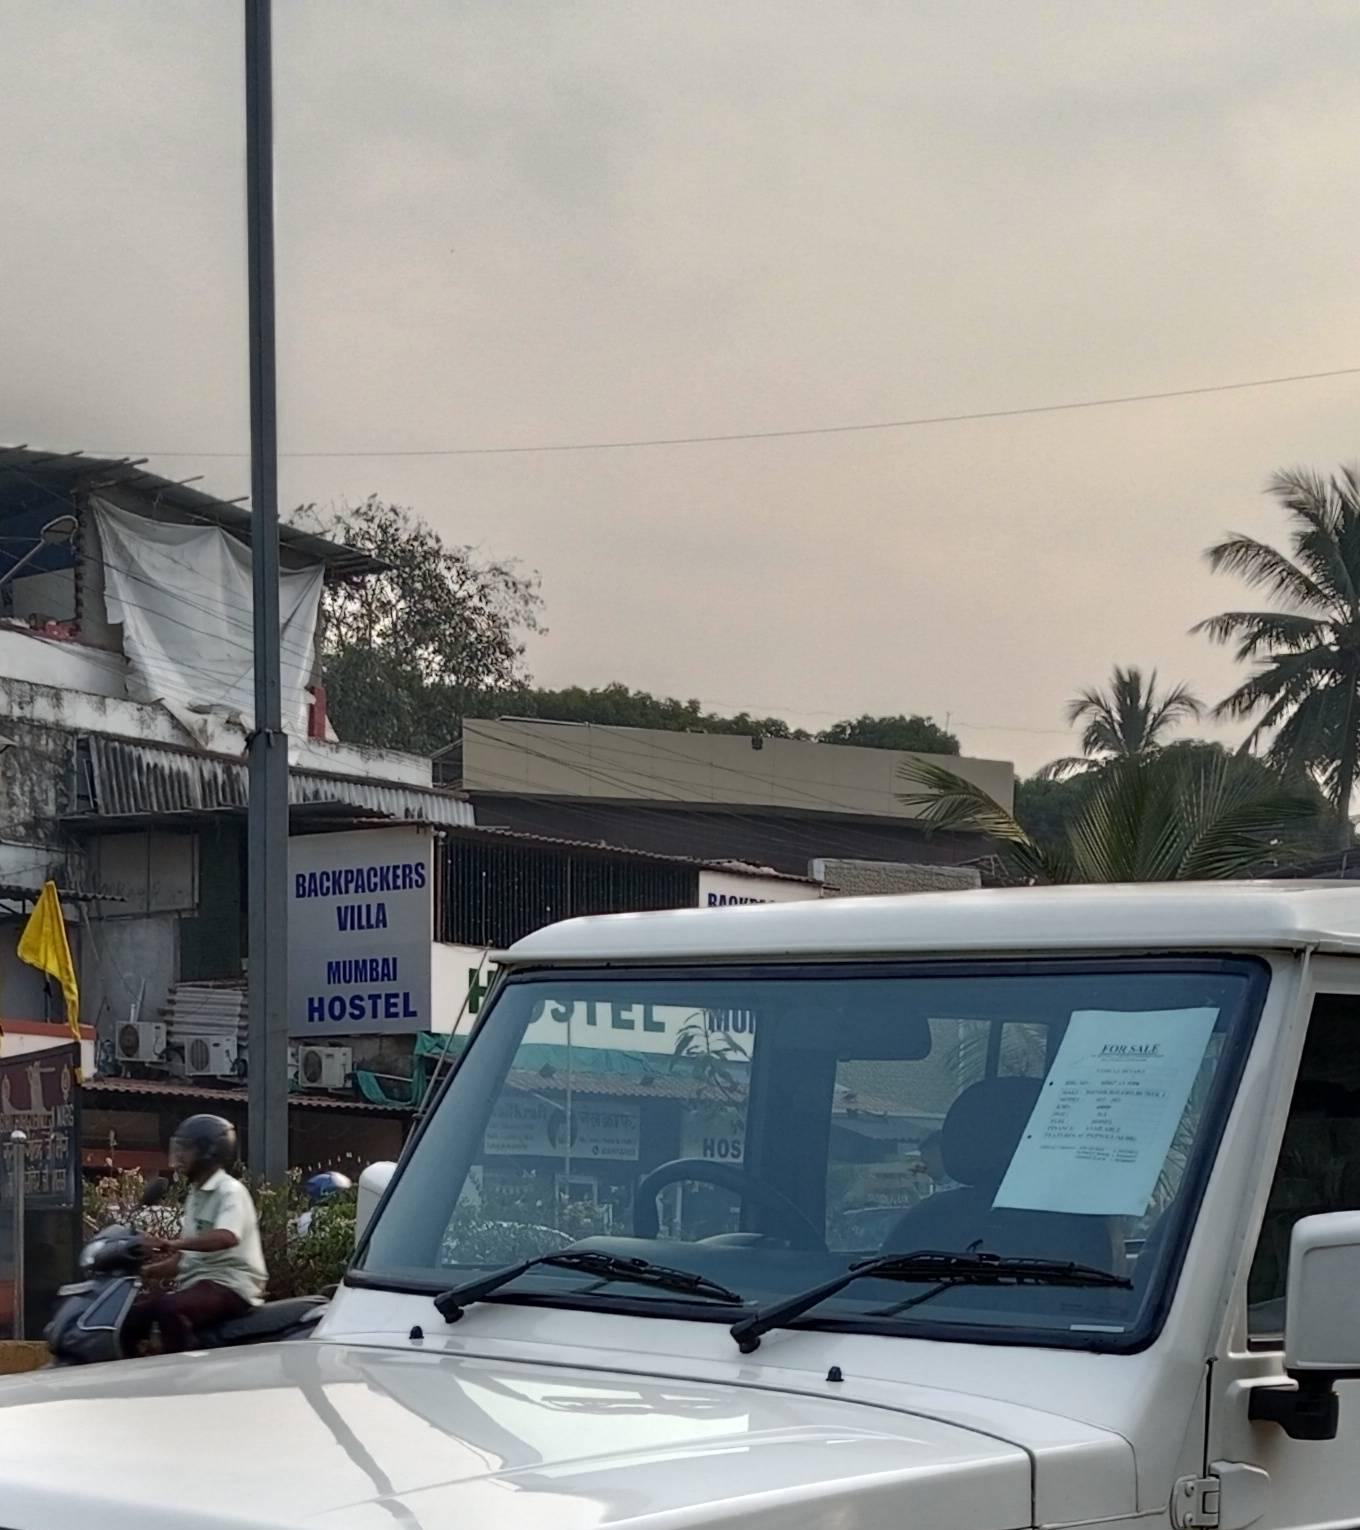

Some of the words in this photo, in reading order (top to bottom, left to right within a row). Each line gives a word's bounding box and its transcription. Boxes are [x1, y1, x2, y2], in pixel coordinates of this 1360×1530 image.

[295, 862, 426, 898] BACKPACKERS
[336, 902, 388, 932] VILLA
[327, 957, 398, 985] MUMBAI
[307, 992, 418, 1023] HOSTEL
